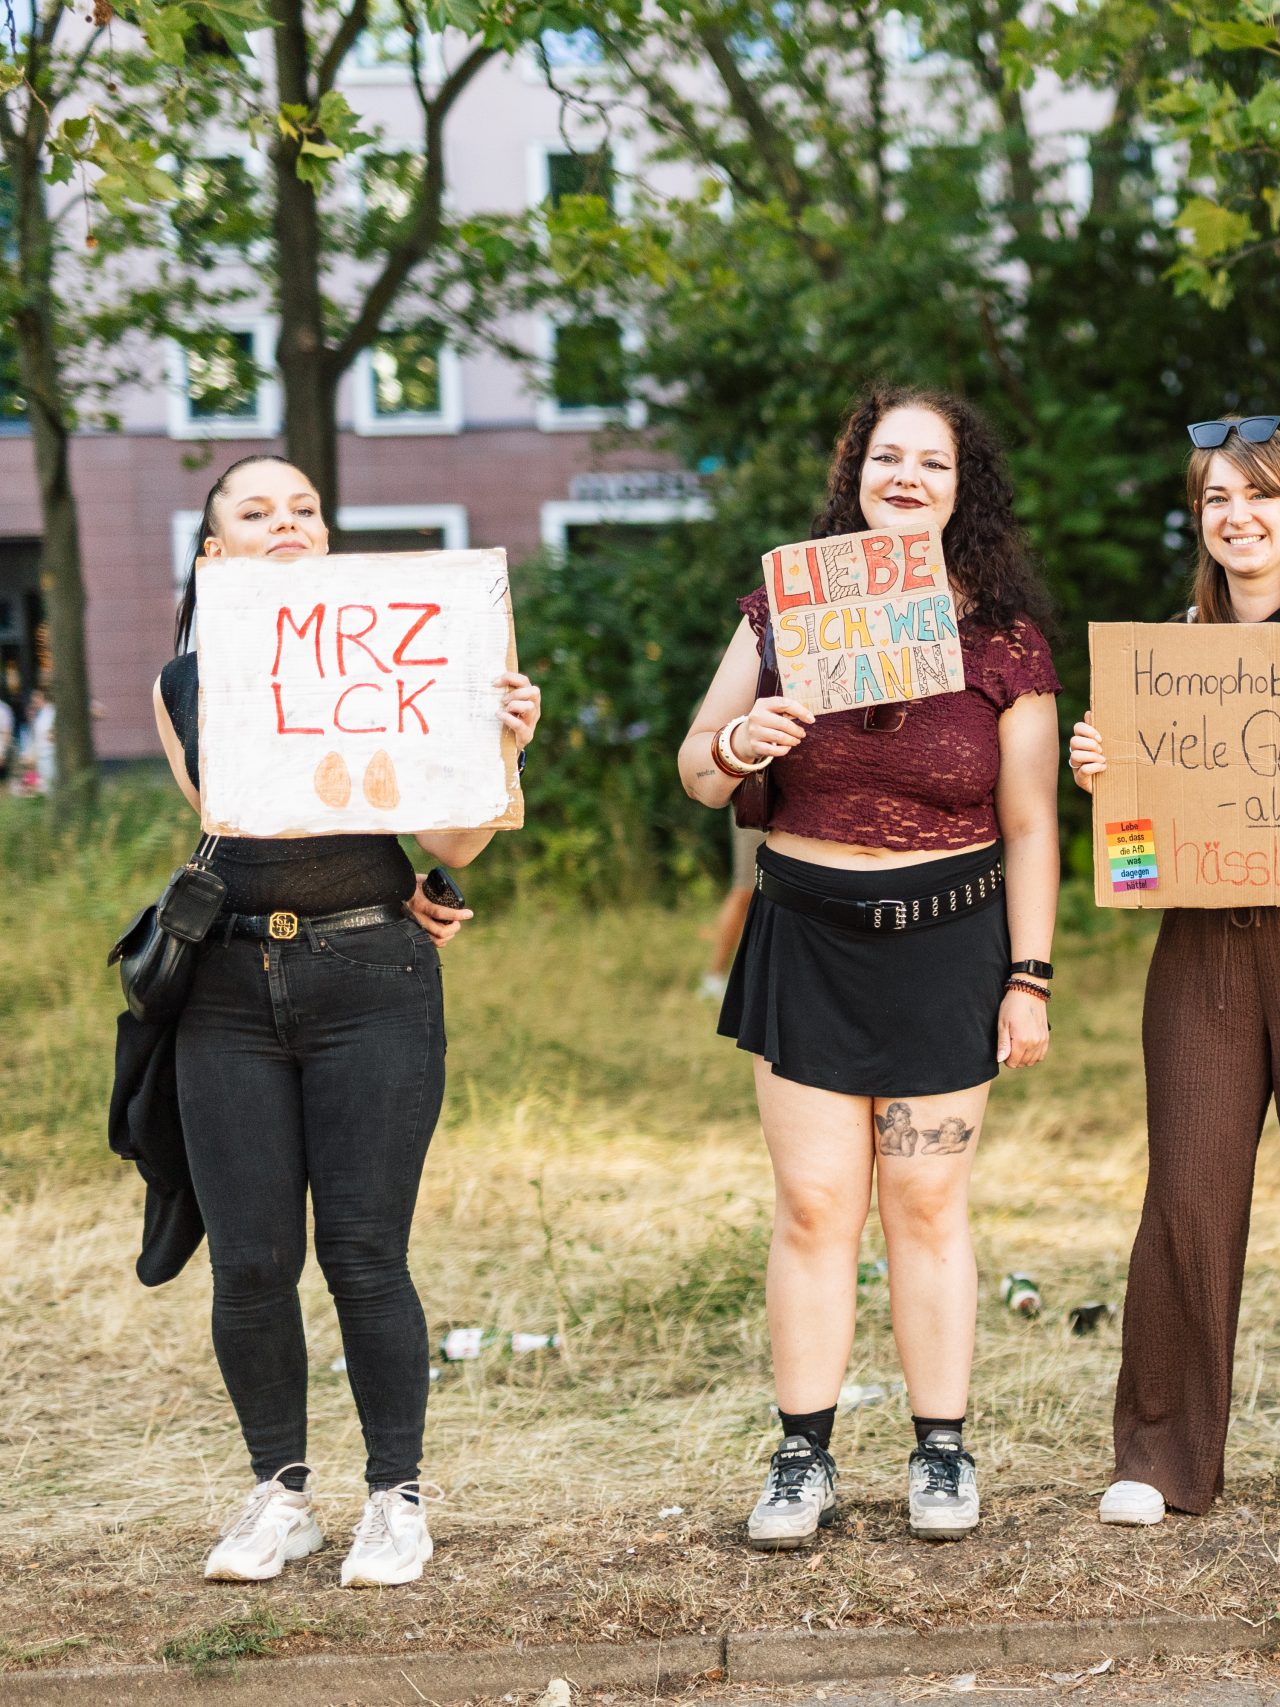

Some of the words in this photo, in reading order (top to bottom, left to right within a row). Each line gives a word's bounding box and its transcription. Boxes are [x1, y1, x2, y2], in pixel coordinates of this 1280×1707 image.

[772, 531, 935, 614] LIEBE
[270, 603, 448, 678] MRZ
[777, 607, 874, 657] SICH
[884, 595, 957, 643] WER
[818, 644, 949, 709] KANN
[271, 679, 436, 736] LCK
[1121, 823, 1139, 831] Lebe
[1129, 833, 1145, 842] dass
[1120, 847, 1130, 855] die
[1132, 845, 1145, 854] AfD
[1127, 857, 1142, 865] was
[1121, 868, 1150, 879] dagegen
